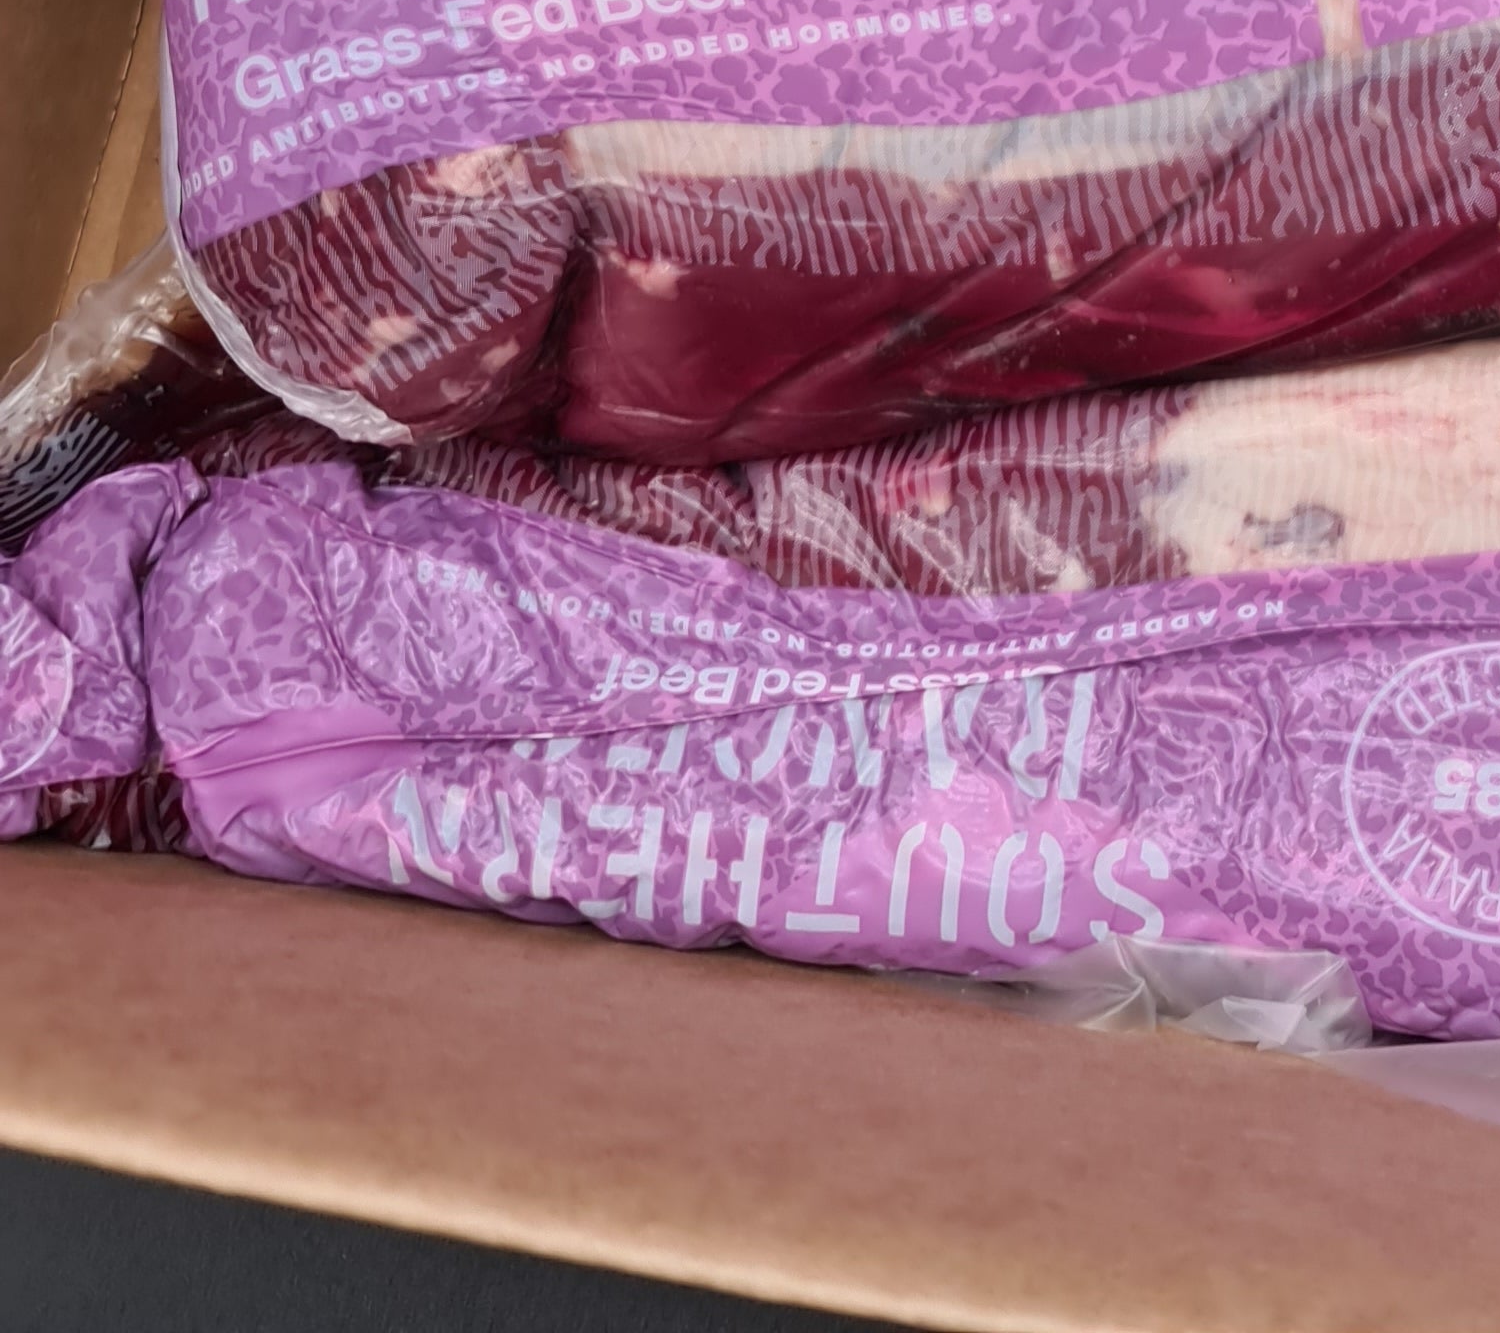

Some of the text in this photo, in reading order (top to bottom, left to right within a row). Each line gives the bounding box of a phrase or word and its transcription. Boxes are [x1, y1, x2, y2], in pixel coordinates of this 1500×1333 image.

[541, 52, 596, 80] NO
[617, 32, 750, 67] ADDED
[769, 3, 1014, 49] HORMONES.
[1094, 609, 1219, 642] ADDED
[1236, 599, 1285, 620] NO
[760, 626, 807, 652] NO
[590, 653, 739, 706] Beef
[392, 777, 1170, 947] SOUTHERN
